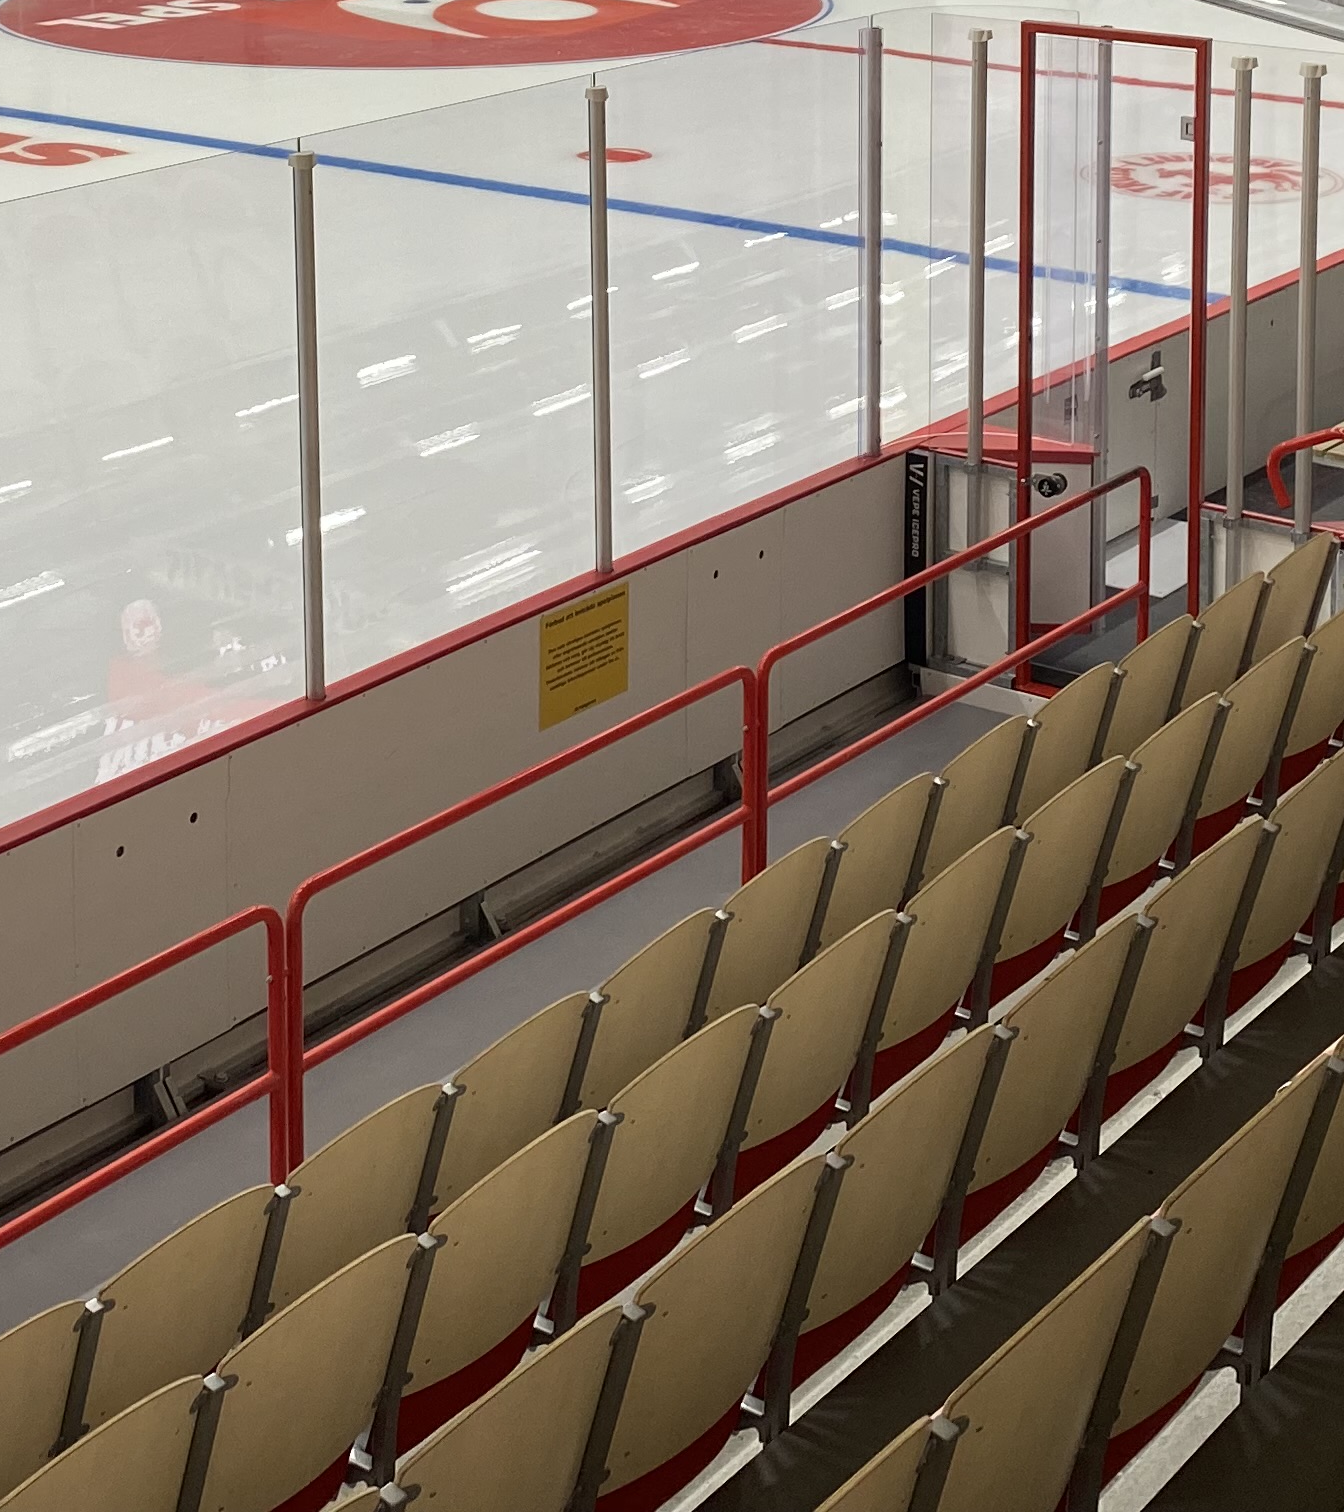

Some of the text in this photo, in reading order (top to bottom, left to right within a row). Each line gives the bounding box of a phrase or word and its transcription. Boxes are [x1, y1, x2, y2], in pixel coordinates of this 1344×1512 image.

[39, 0, 242, 30] SPEL
[911, 488, 920, 558] VEPE ICEPRO
